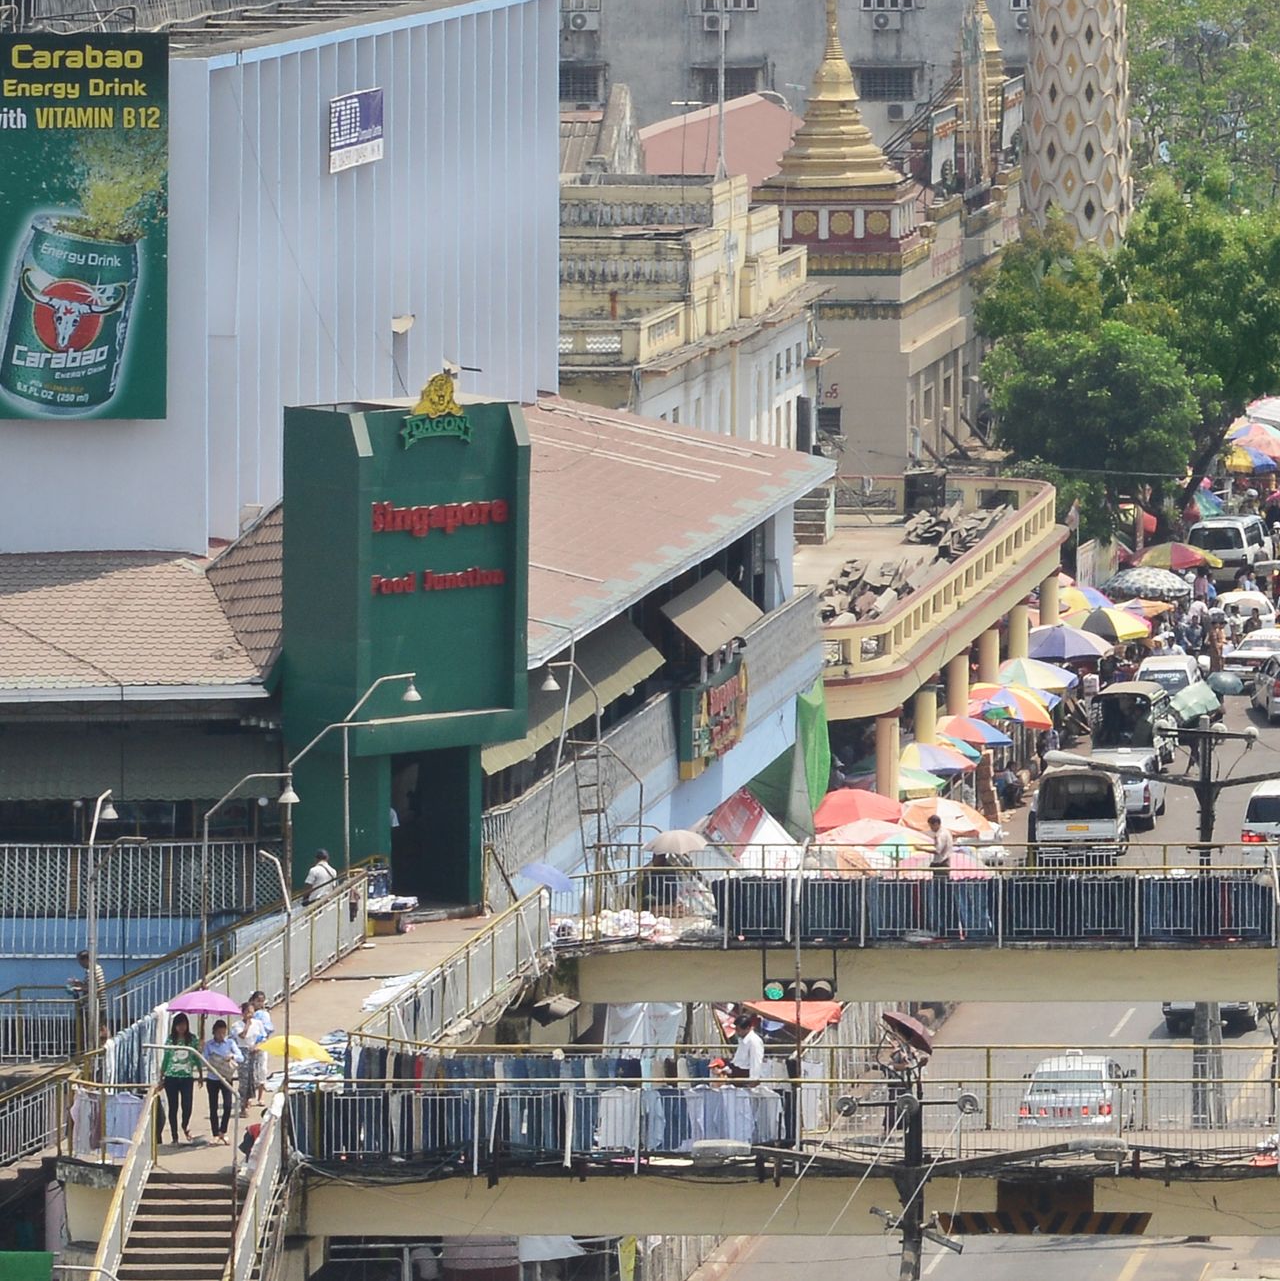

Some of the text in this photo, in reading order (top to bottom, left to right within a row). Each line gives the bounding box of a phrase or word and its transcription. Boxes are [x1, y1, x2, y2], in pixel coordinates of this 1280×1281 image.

[11, 44, 143, 69] Carabao
[3, 78, 148, 99] Energy Drink
[35, 107, 114, 129] VITAMIN
[123, 107, 161, 129] B12
[41, 242, 121, 267] Energy Drink
[12, 344, 109, 369] Carabao
[411, 417, 467, 433] DAGON
[371, 500, 508, 537] Singapore
[371, 566, 505, 596] Food Junction
